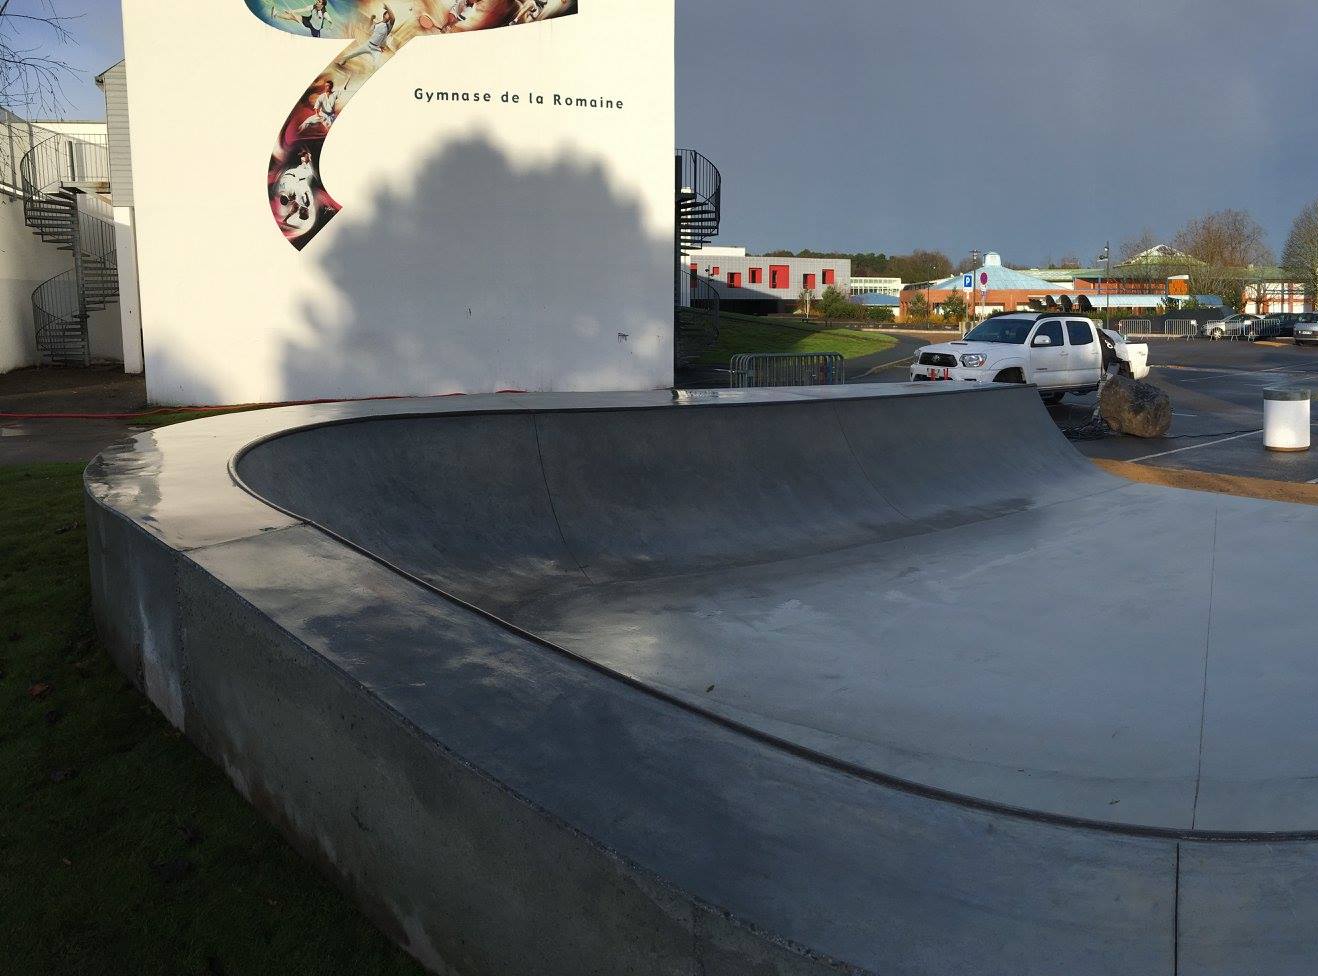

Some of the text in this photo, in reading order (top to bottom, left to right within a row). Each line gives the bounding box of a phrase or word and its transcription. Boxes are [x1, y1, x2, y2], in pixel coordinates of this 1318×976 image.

[414, 87, 624, 110] Gymnase de la Romaine
